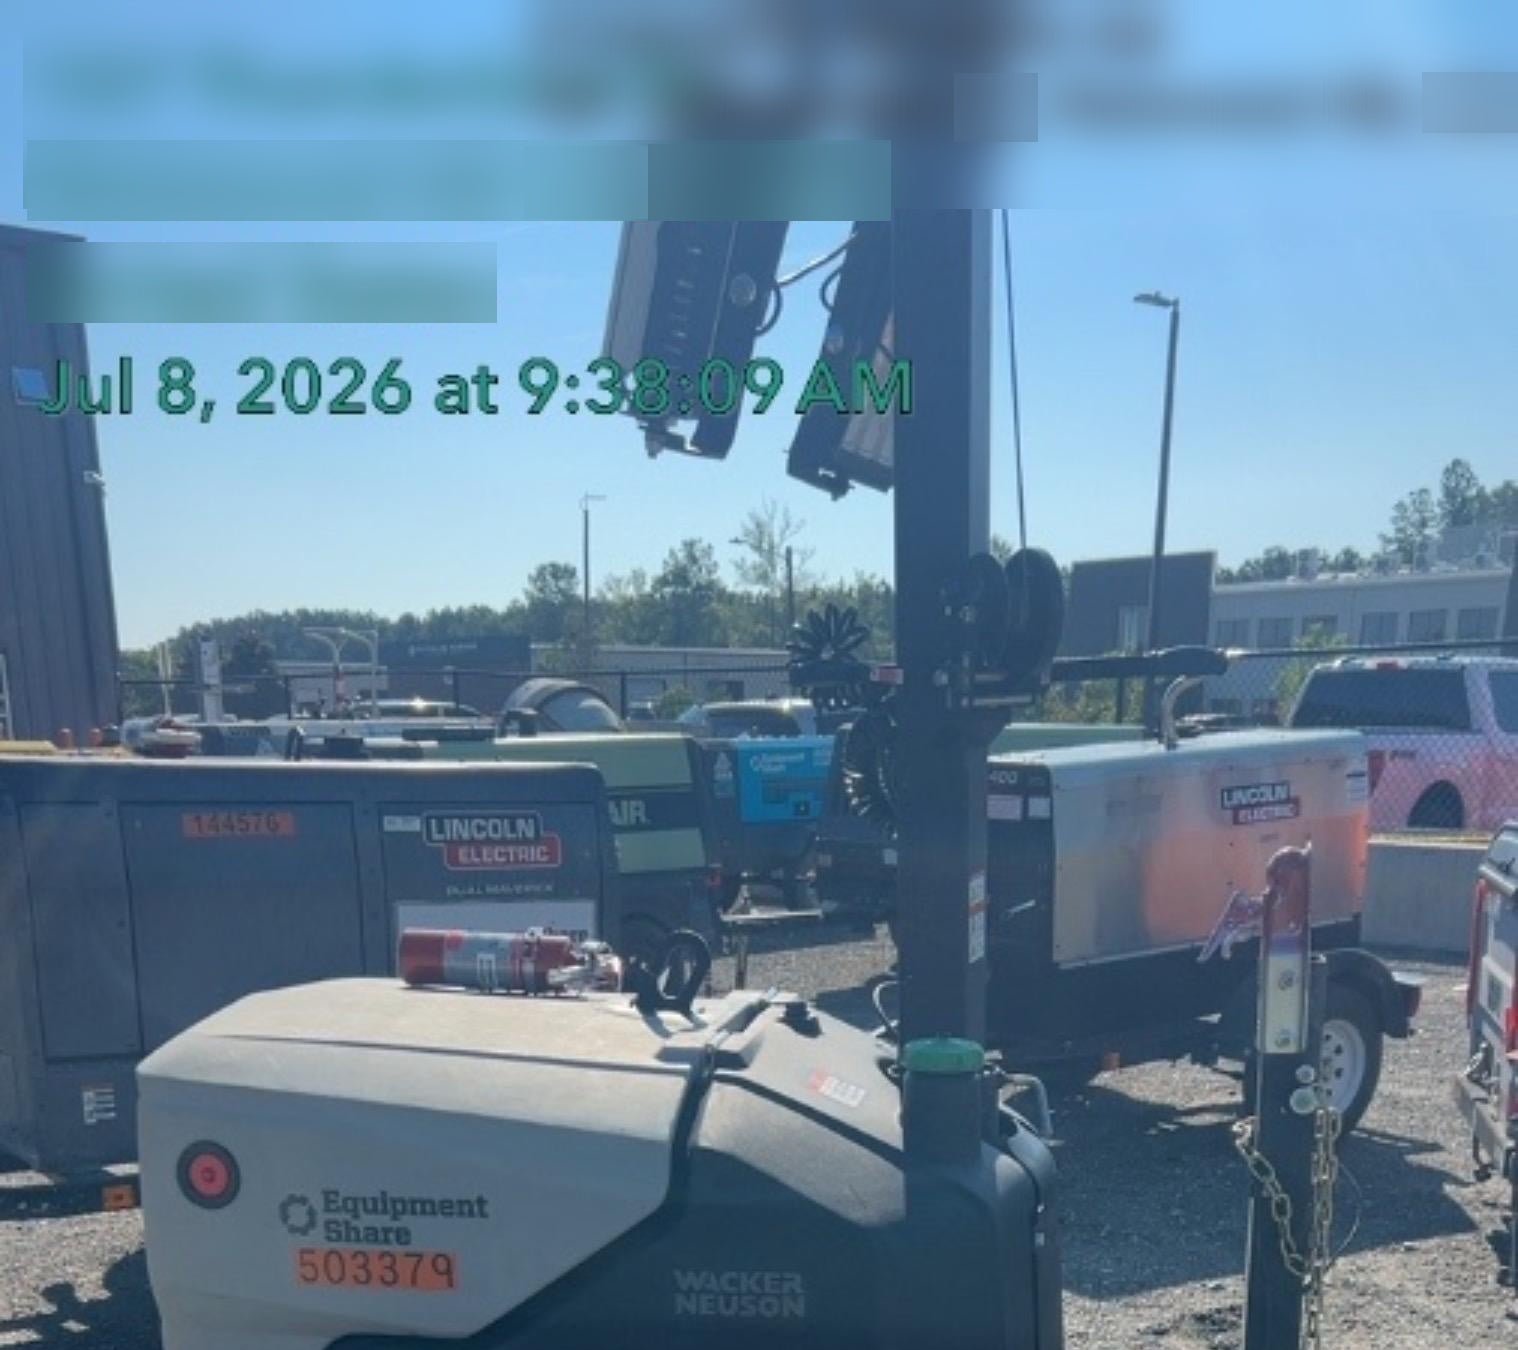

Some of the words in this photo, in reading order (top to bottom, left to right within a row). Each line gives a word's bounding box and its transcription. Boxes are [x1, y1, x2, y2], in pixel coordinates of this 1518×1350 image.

[1223, 784, 1289, 809] LINCOLN
[429, 817, 536, 841] LINCOLN
[457, 844, 551, 864] ELECTRIC
[321, 1189, 489, 1221] Equipment
[323, 1219, 412, 1246] Share
[298, 1248, 454, 1289] 503379
[672, 1268, 806, 1294] WACKER
[673, 1292, 806, 1318] NEUSON
